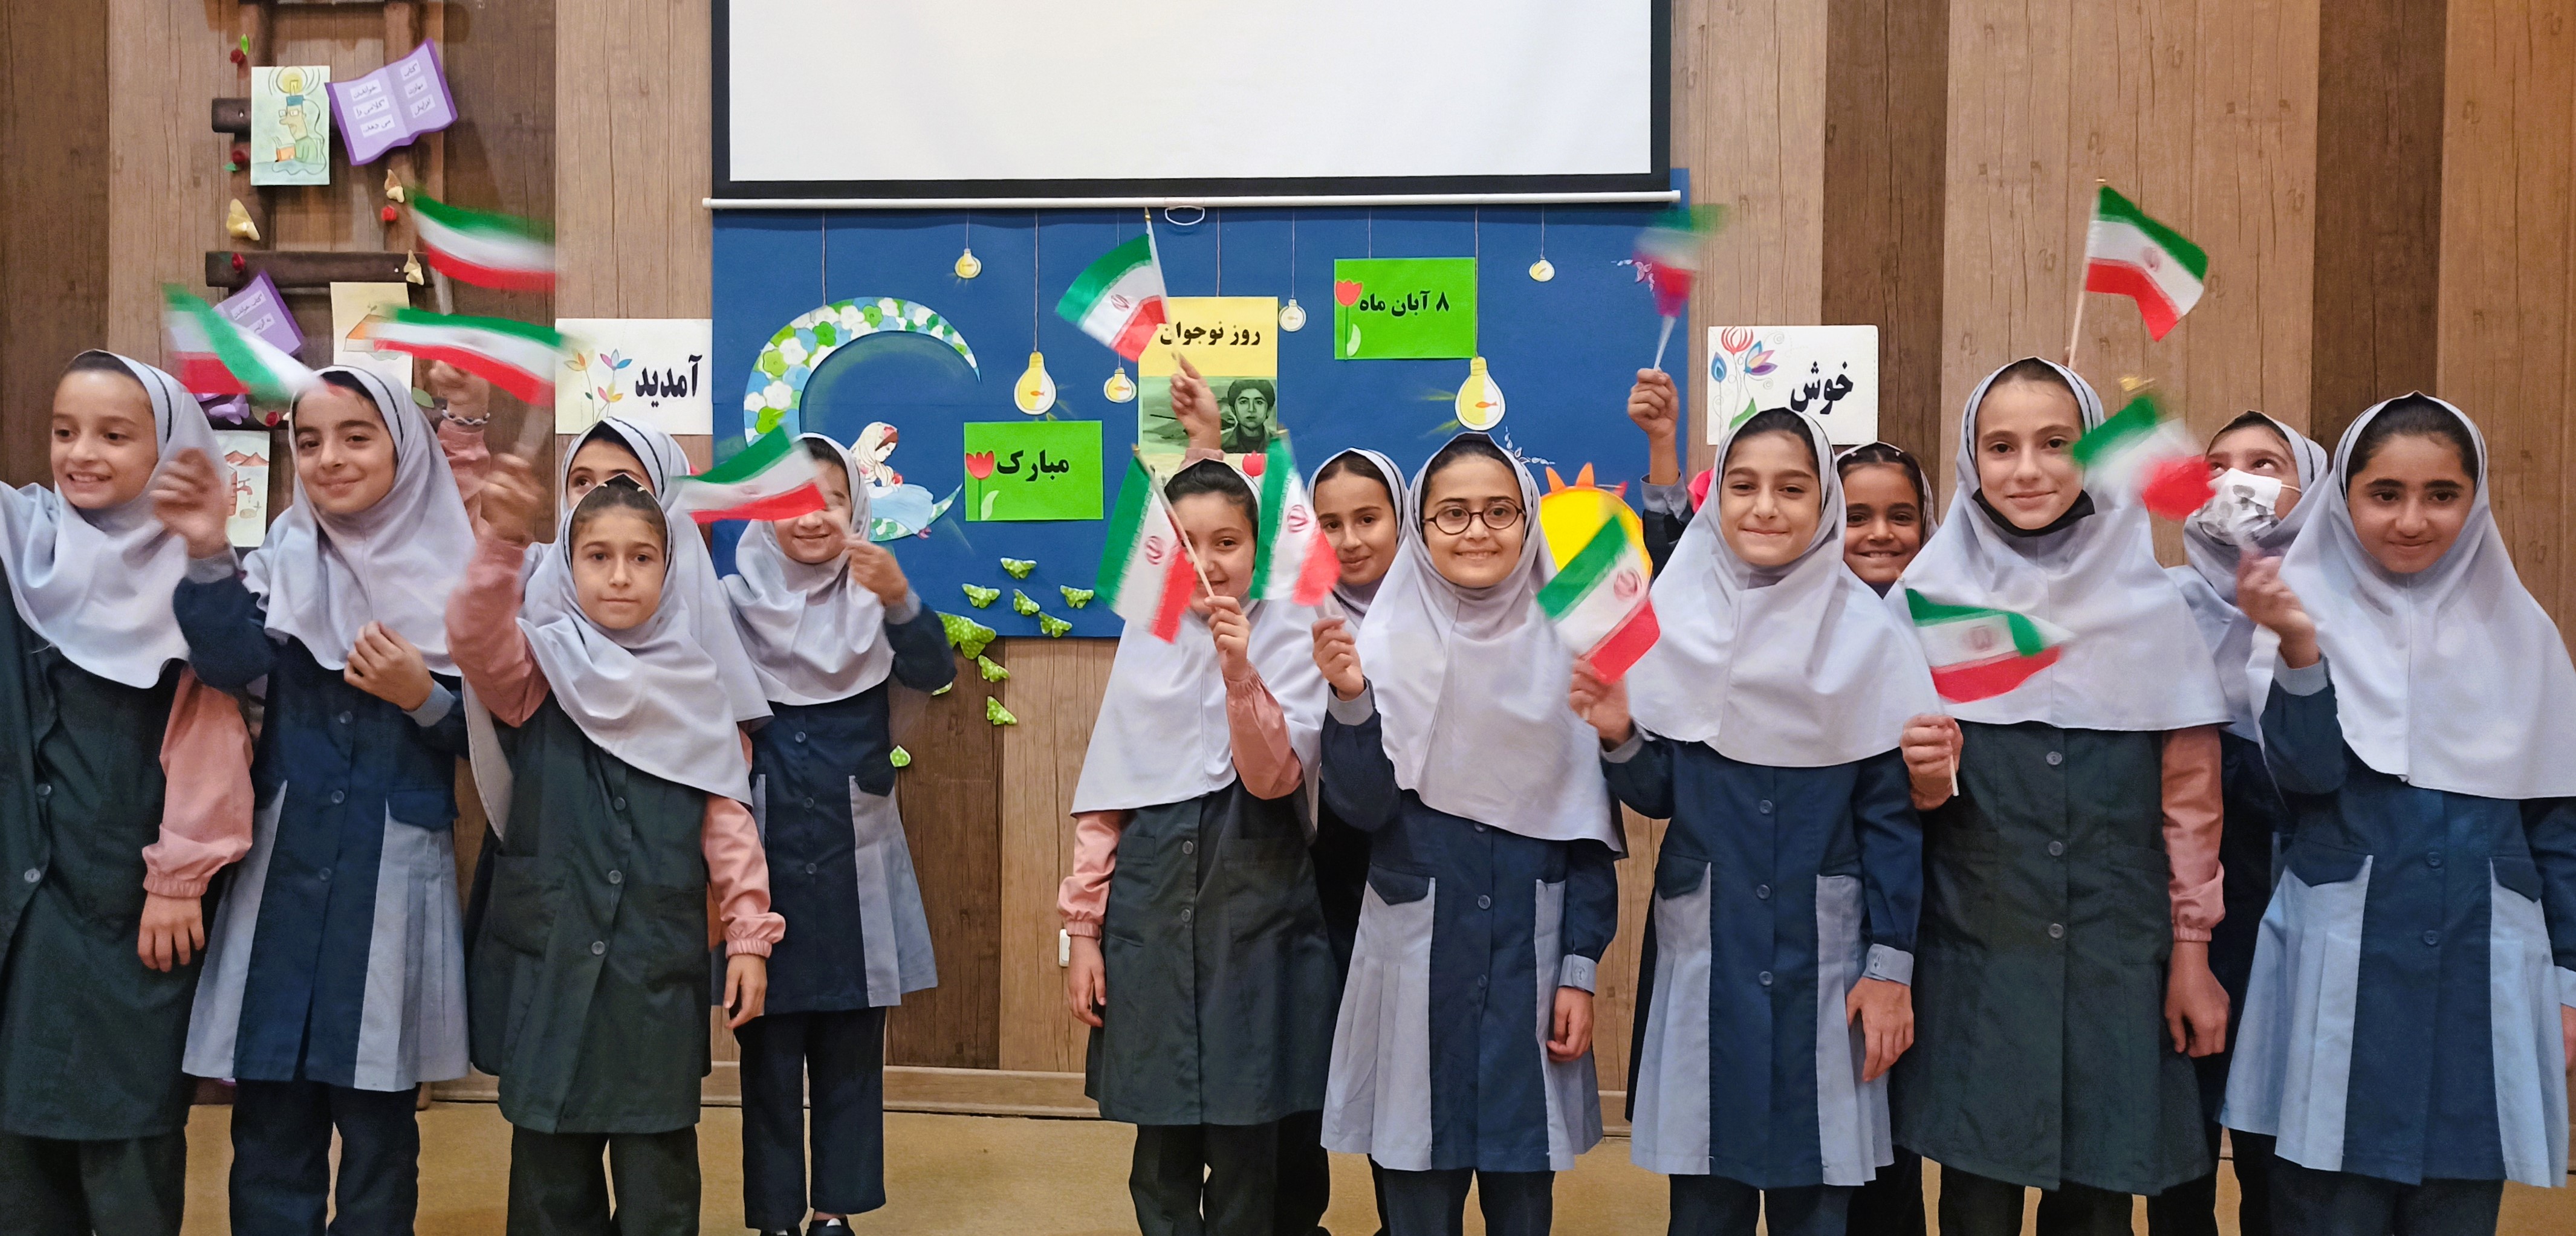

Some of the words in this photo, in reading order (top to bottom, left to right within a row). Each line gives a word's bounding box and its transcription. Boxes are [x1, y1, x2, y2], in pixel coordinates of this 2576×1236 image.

[1360, 293, 1386, 311] ماه
[1392, 290, 1431, 317] آبان
[1436, 291, 1450, 312] ۸
[1160, 321, 1224, 345] نوجوان
[1230, 325, 1260, 345] روز
[635, 354, 702, 407] آمدید
[1791, 361, 1854, 415] خوش
[997, 449, 1069, 482] مبارک
